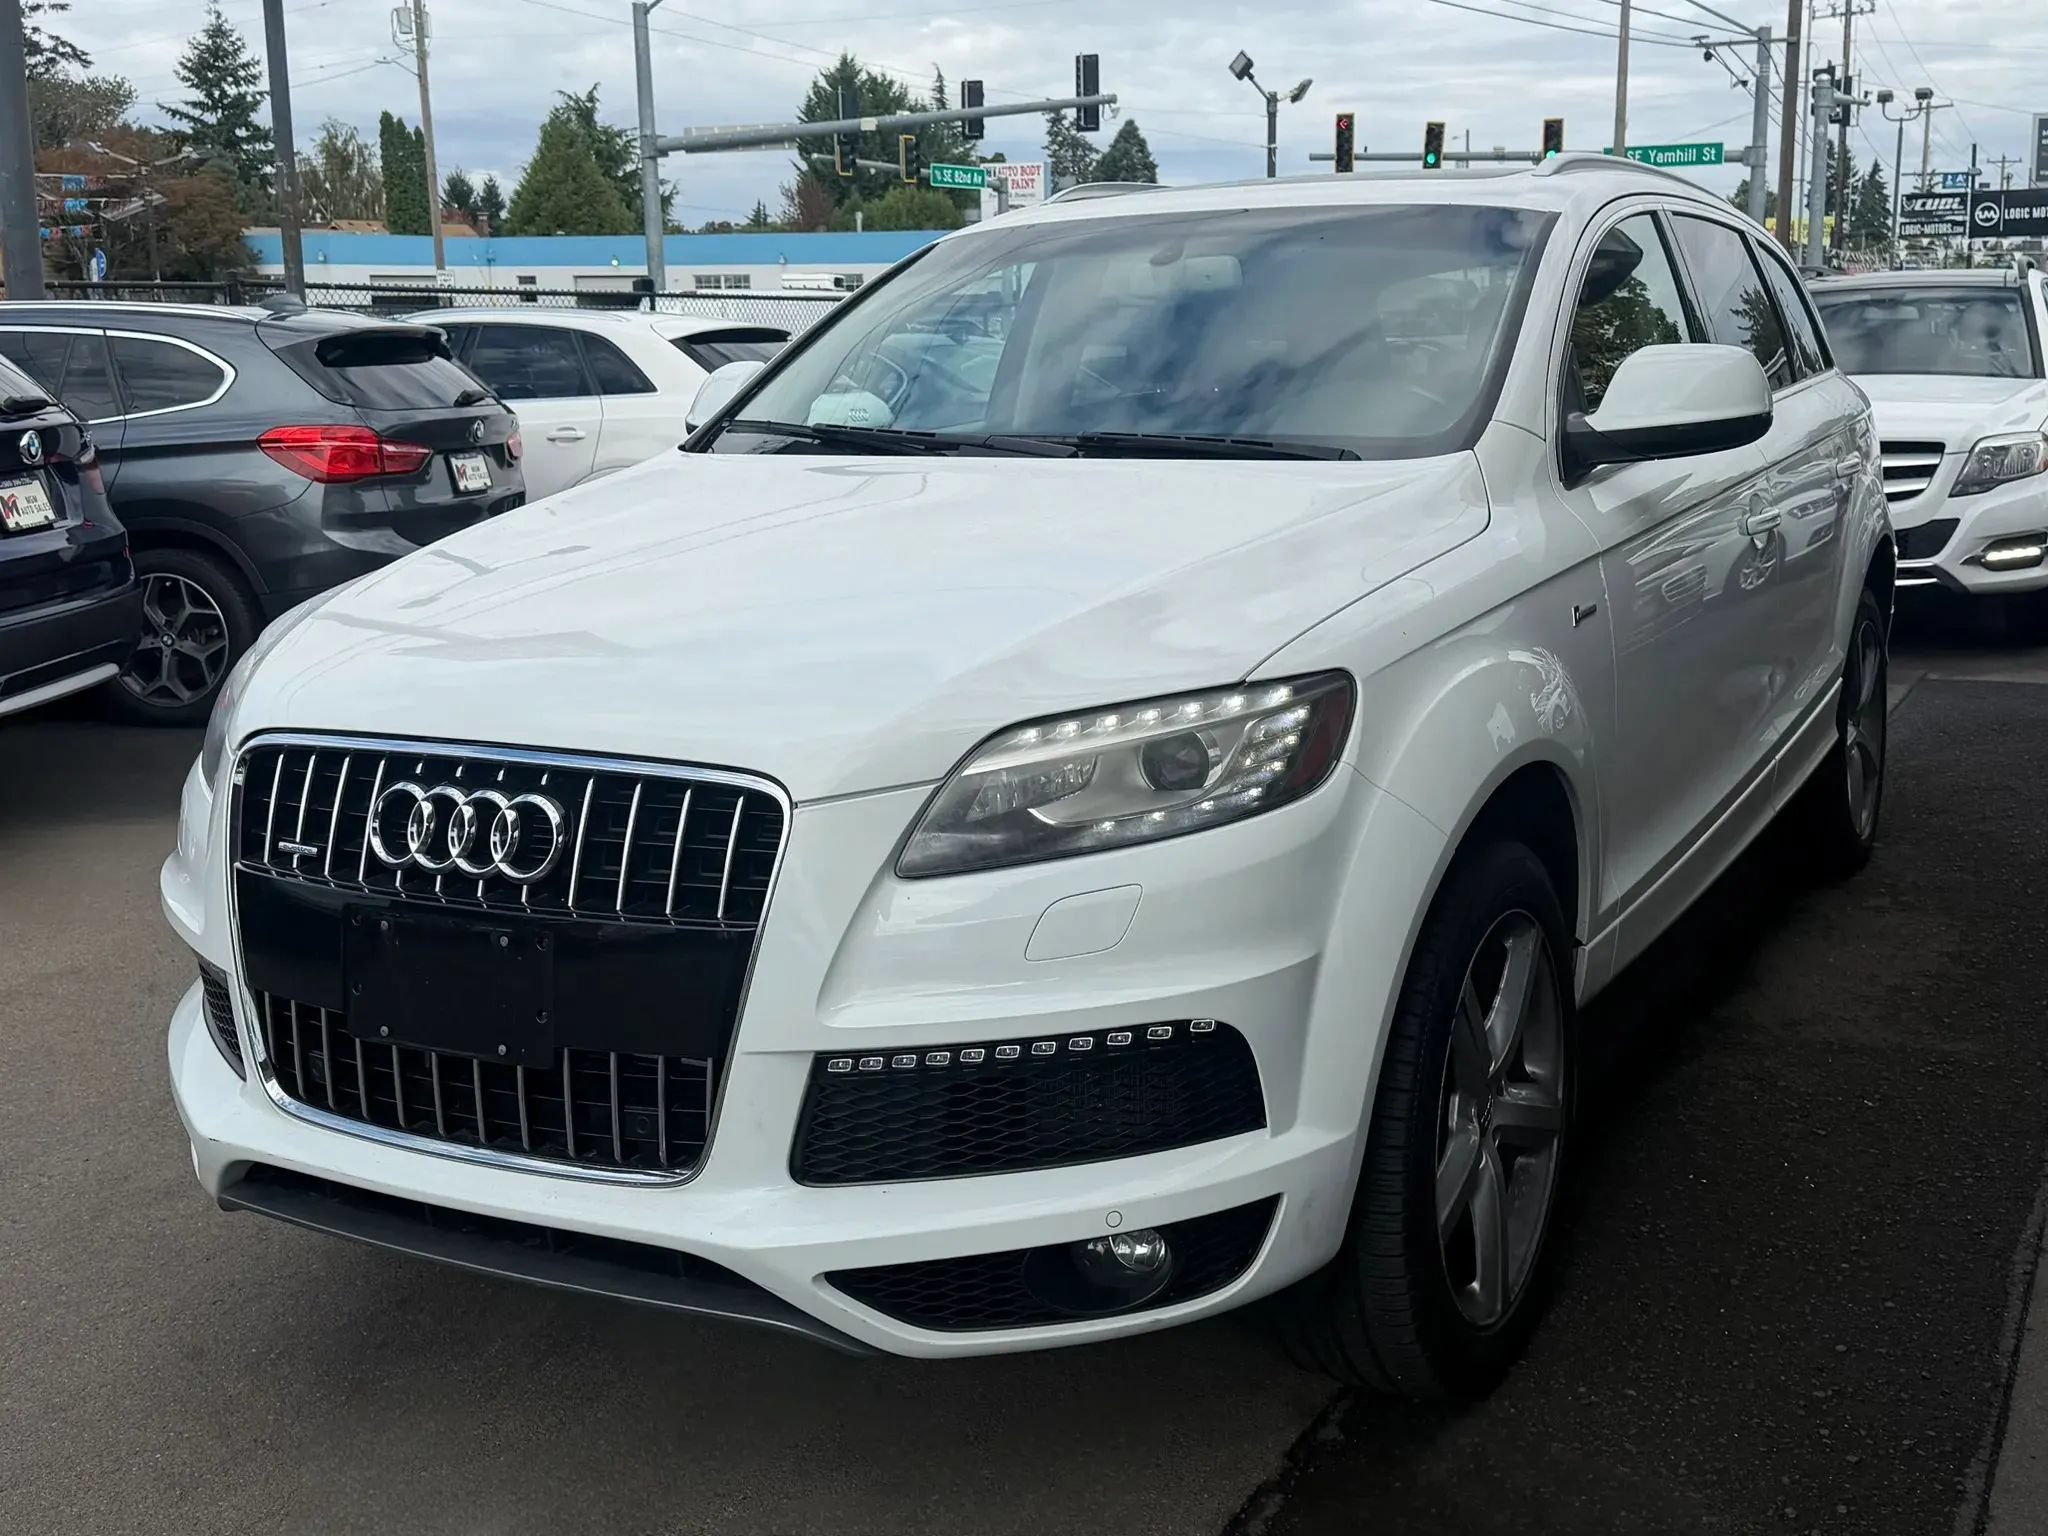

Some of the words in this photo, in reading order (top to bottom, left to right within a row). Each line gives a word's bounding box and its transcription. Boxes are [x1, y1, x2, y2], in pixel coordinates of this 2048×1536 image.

[1648, 148, 1697, 163] Yamhill
[1702, 147, 1716, 161] St
[943, 169, 953, 182] SE
[954, 170, 972, 184] 82nd
[973, 172, 982, 184] Av
[1020, 165, 1041, 176] BODY
[1011, 178, 1035, 189] PAINT
[2004, 207, 2030, 219] LOGIC
[20, 504, 35, 515] AUTO
[34, 502, 51, 513] SALES
